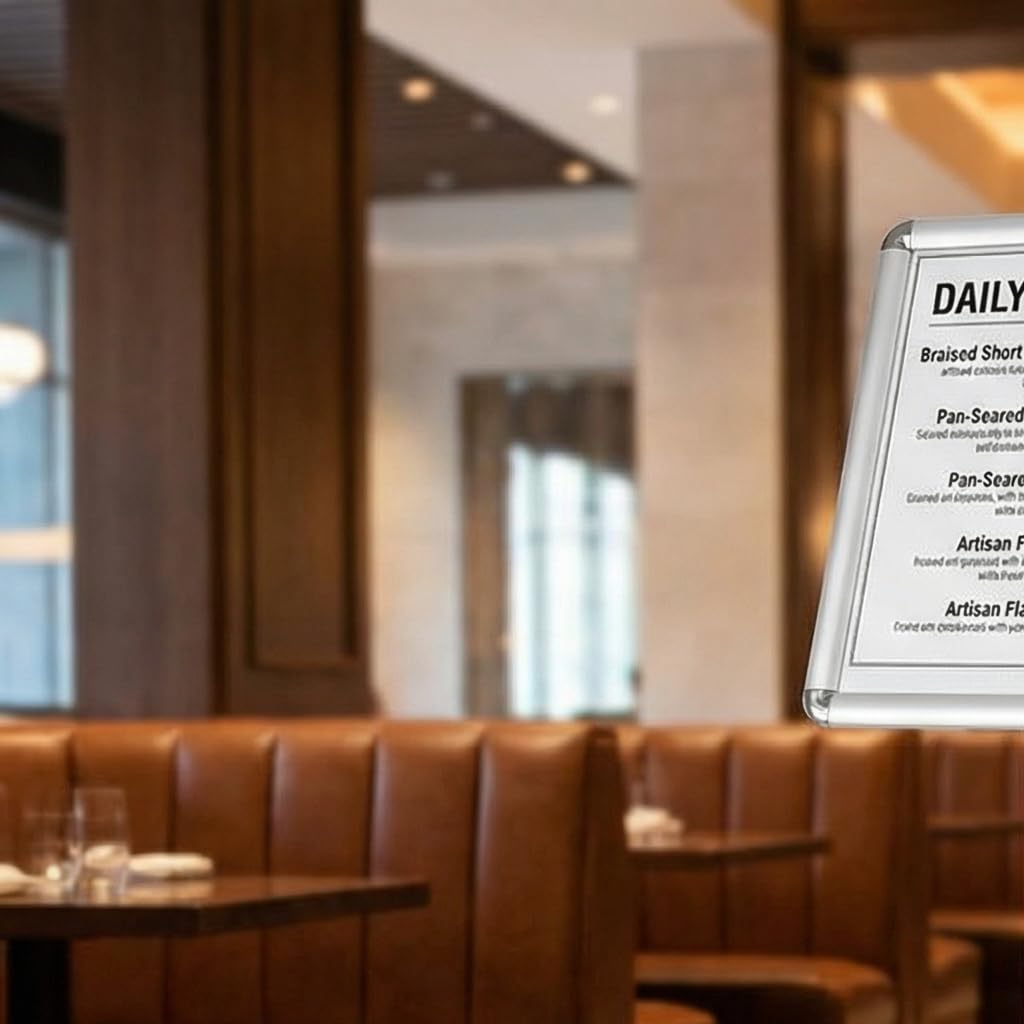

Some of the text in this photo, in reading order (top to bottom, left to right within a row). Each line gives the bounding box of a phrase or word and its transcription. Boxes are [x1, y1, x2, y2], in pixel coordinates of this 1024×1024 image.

[920, 345, 978, 363] Braised
[981, 344, 1023, 361] Short
[936, 406, 1024, 424] Pan-Seared
[956, 534, 1012, 552] Artisan
[945, 599, 1001, 617] Artisan
